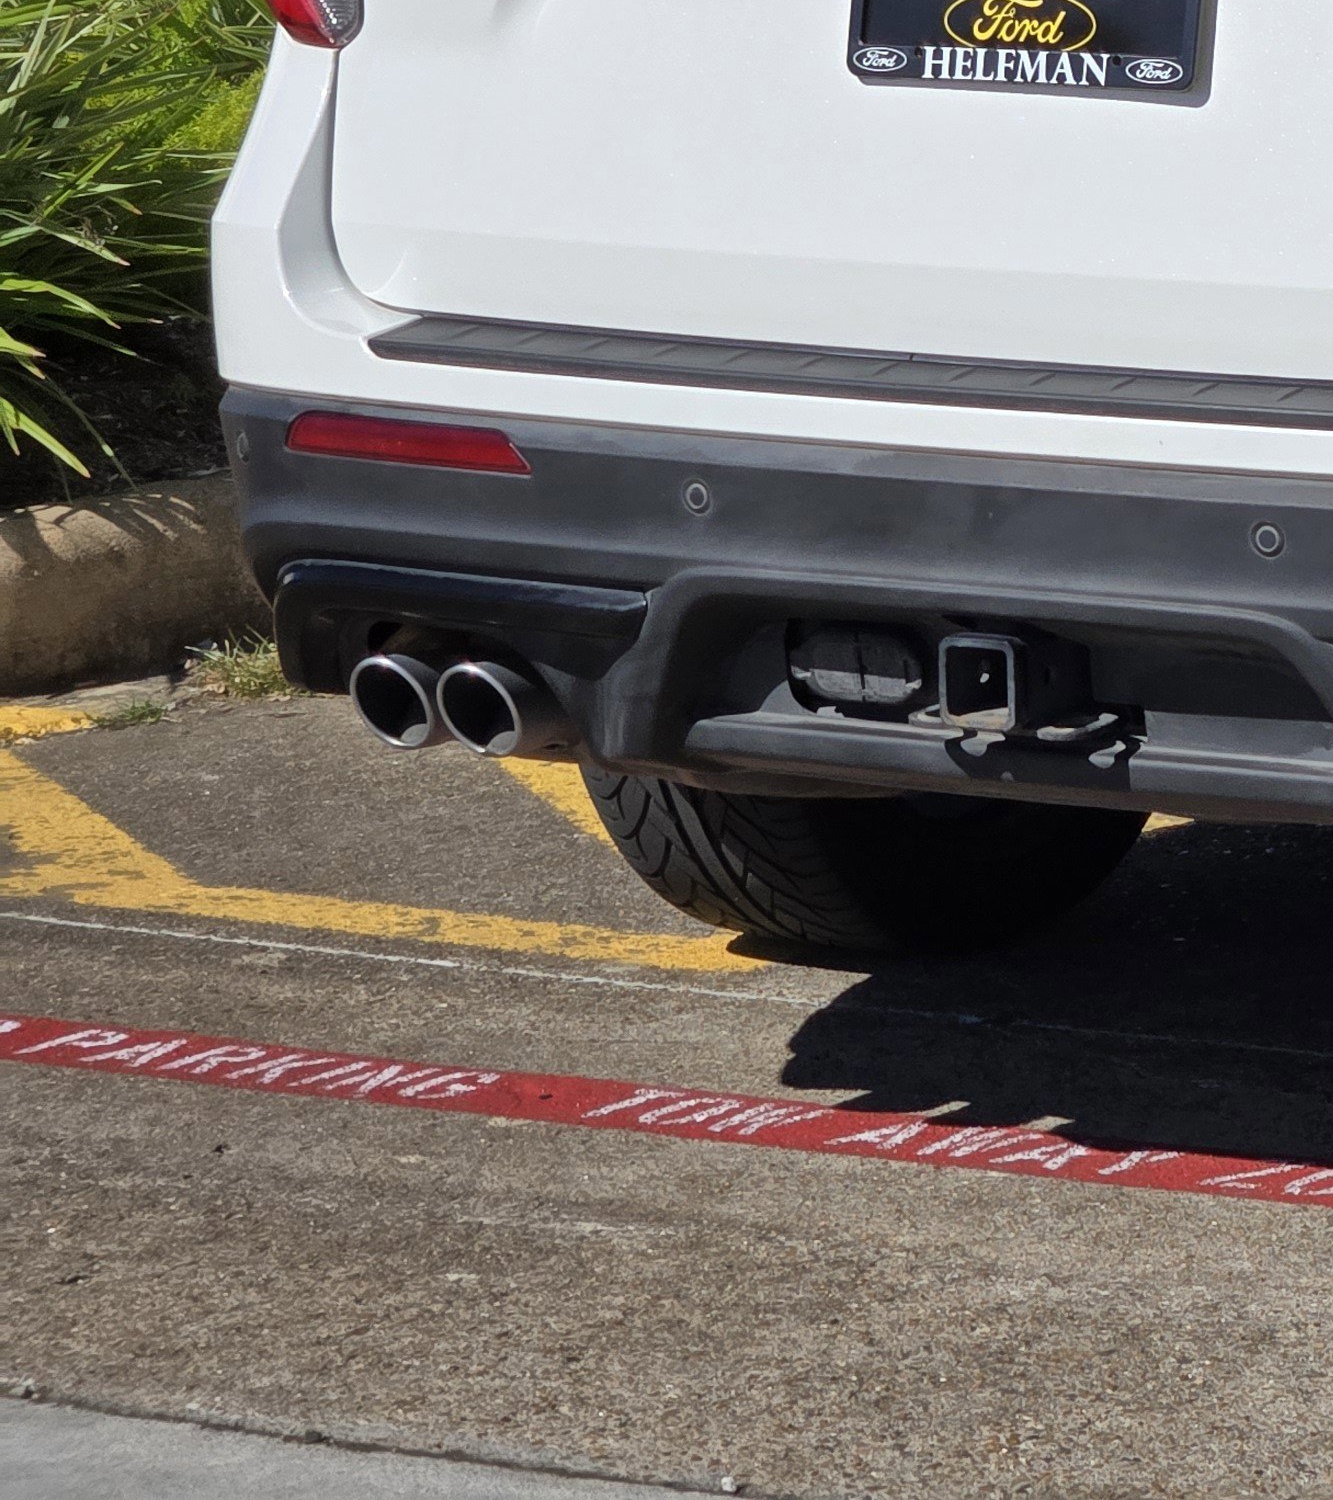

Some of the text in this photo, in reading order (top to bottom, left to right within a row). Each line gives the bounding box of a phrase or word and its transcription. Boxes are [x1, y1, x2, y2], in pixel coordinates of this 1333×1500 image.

[862, 51, 897, 68] Ford
[921, 47, 1110, 87] HELFMAN
[1135, 65, 1172, 81] Ford
[12, 1029, 501, 1100] PARKING
[581, 1088, 836, 1136] TOW
[823, 1119, 1182, 1175] AWAY
